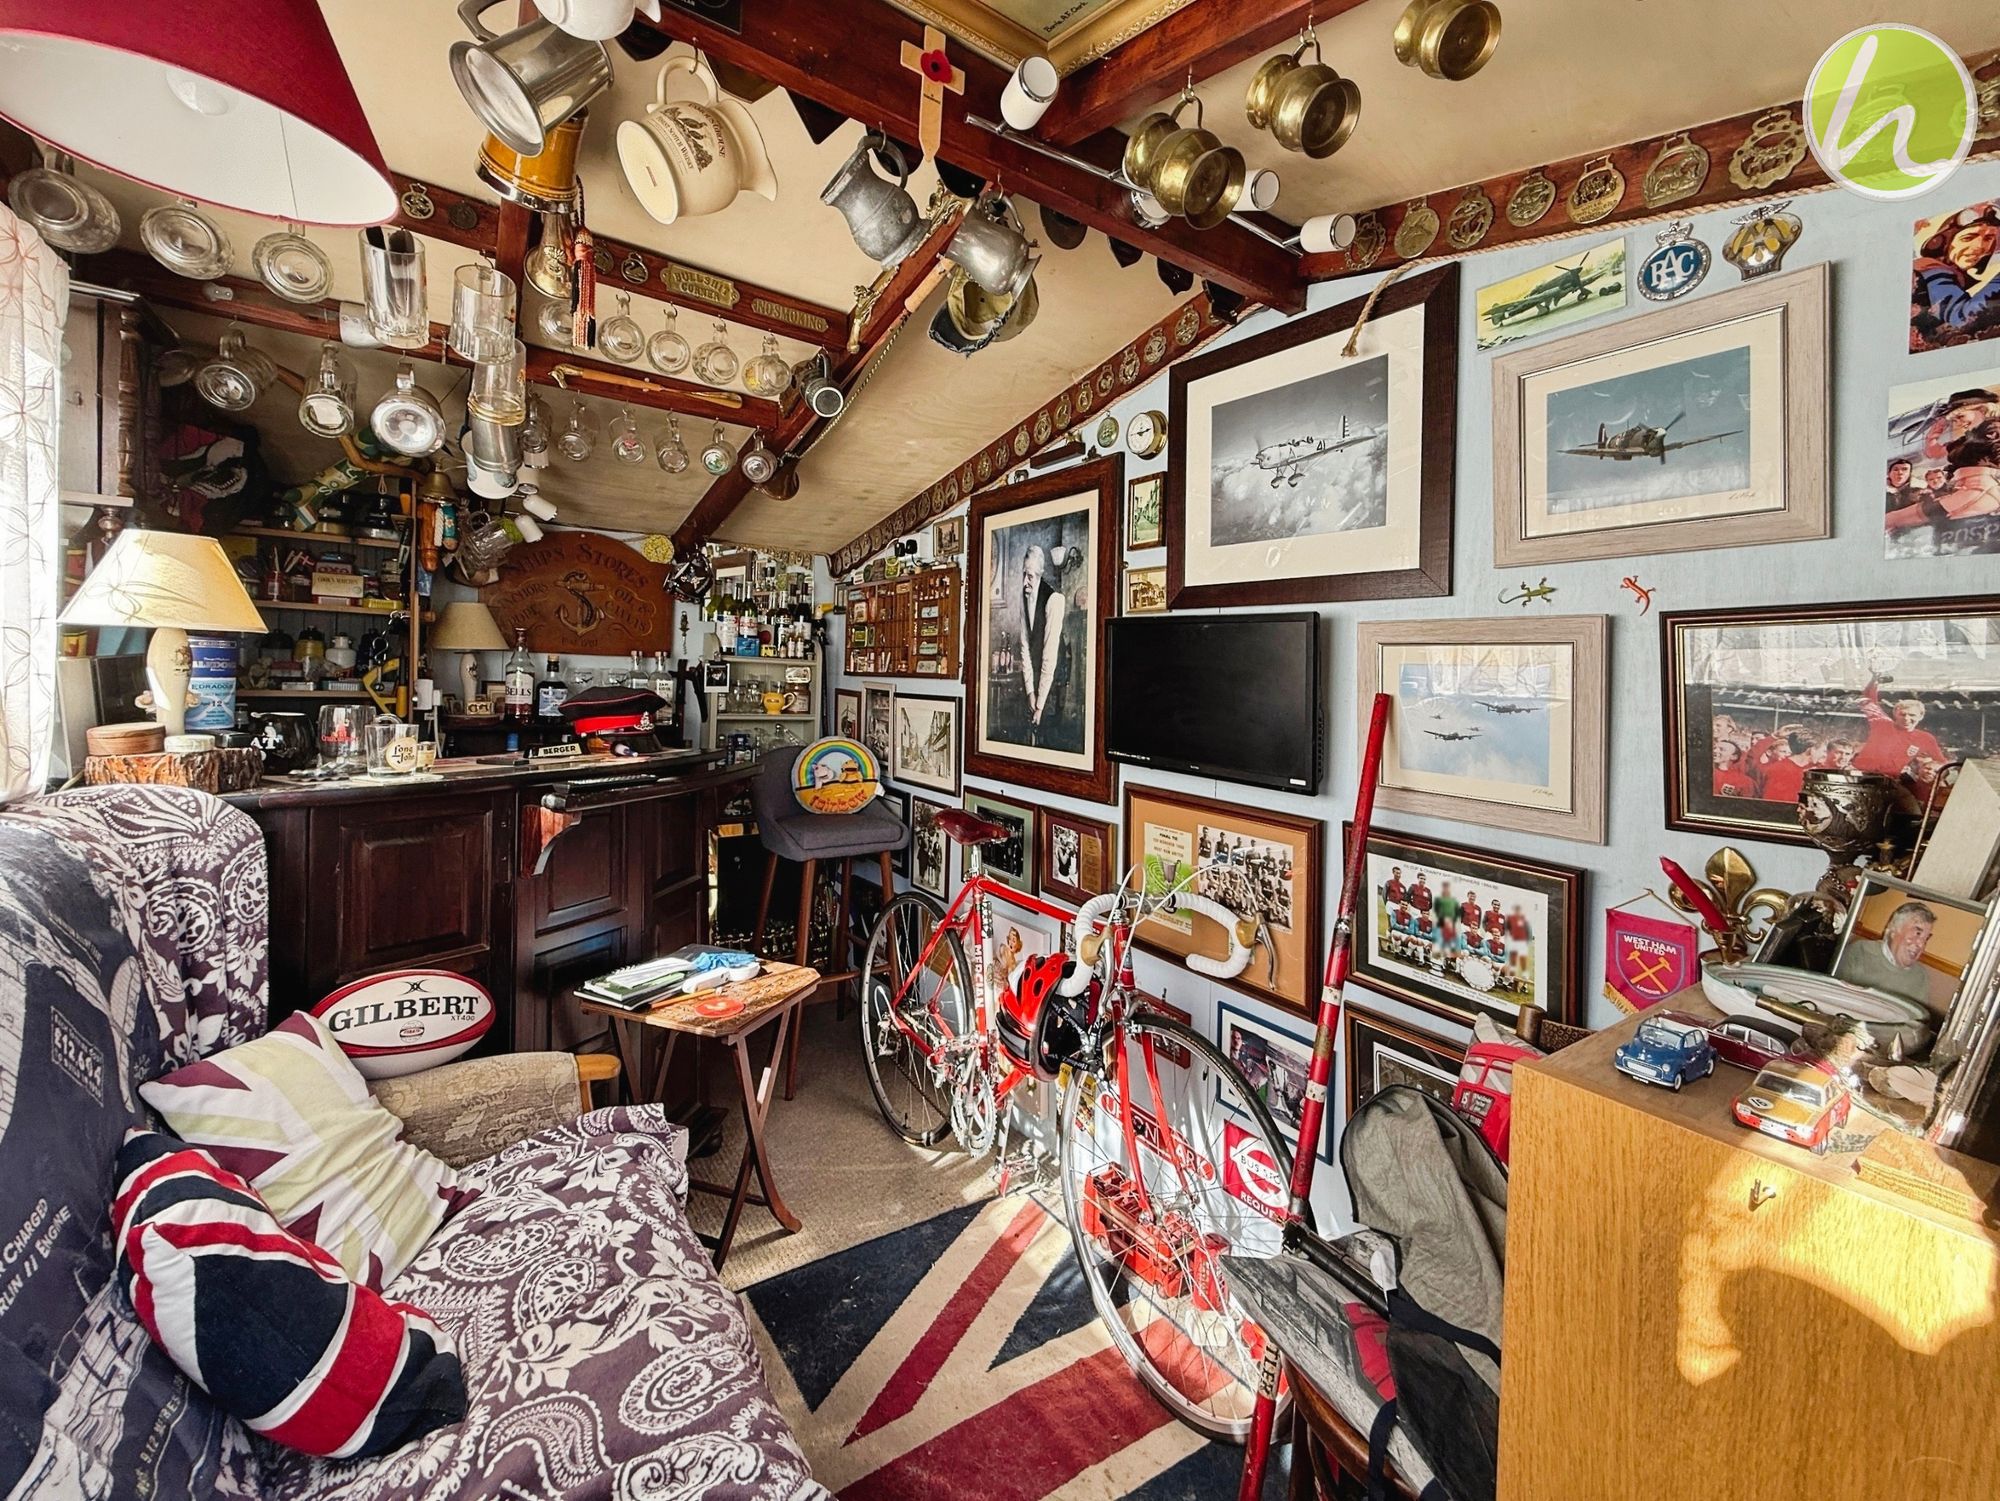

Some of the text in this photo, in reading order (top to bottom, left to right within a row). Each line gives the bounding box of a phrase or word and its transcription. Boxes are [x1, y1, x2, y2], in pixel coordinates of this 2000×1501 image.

[1650, 249, 1696, 291] RAC
[674, 271, 730, 297] BULLSHIT
[680, 282, 721, 303] CORNER
[575, 543, 649, 588] STORES
[543, 745, 577, 755] BERGER
[1623, 934, 1677, 955] WEST HAM
[1634, 943, 1666, 956] UNITED
[328, 996, 479, 1033] GILBERT
[1240, 1154, 1260, 1173] BUS
[3, 1197, 49, 1264] CHARGED
[34, 1204, 72, 1259] ENGINE
